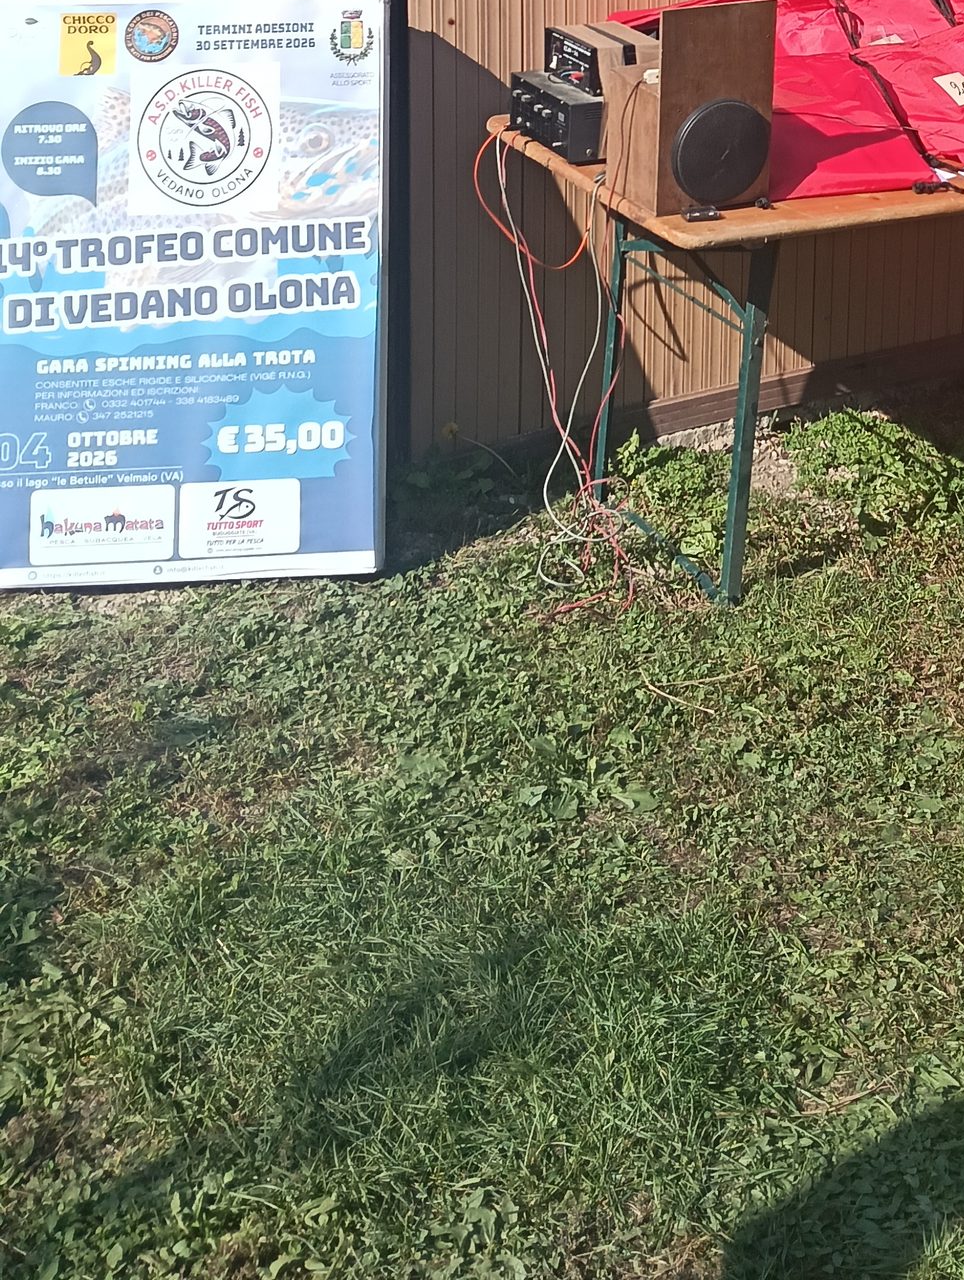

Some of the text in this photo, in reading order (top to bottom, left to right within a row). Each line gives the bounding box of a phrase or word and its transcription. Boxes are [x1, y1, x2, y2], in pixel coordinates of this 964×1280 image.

[62, 15, 116, 25] CHICCO
[197, 22, 315, 35] TERMINI ADESIONI
[196, 37, 316, 51] 30 SETTEMBRE 2026
[148, 75, 263, 125] A.S.D. KILLER FISH
[14, 123, 87, 134] RITROVO ORE
[14, 155, 84, 166] INIZIO GARA
[156, 167, 254, 199] VEDANO OLONA
[55, 231, 204, 270] TROFEO
[212, 221, 366, 257] COMUNE
[7, 276, 356, 329] DI VEDANO OLONA
[36, 349, 316, 374] GARA SPINNING ALLA TROTA
[35, 379, 99, 390] CONSENTITE
[101, 377, 137, 387] ESCHE
[139, 376, 172, 385] RIGIDE
[174, 376, 181, 384] E
[184, 373, 248, 384] SILICONICHE
[34, 385, 199, 400] PER INFORMAZIONI ED ISCRIZIONI
[0, 429, 159, 470] 04 OTTOBRE
[66, 450, 118, 467] 2026
[15, 478, 23, 488] il
[25, 476, 49, 490] lago
[160, 471, 184, 483] (VA)
[39, 513, 102, 539] hakuna
[206, 519, 264, 531] TUTTO SPORT
